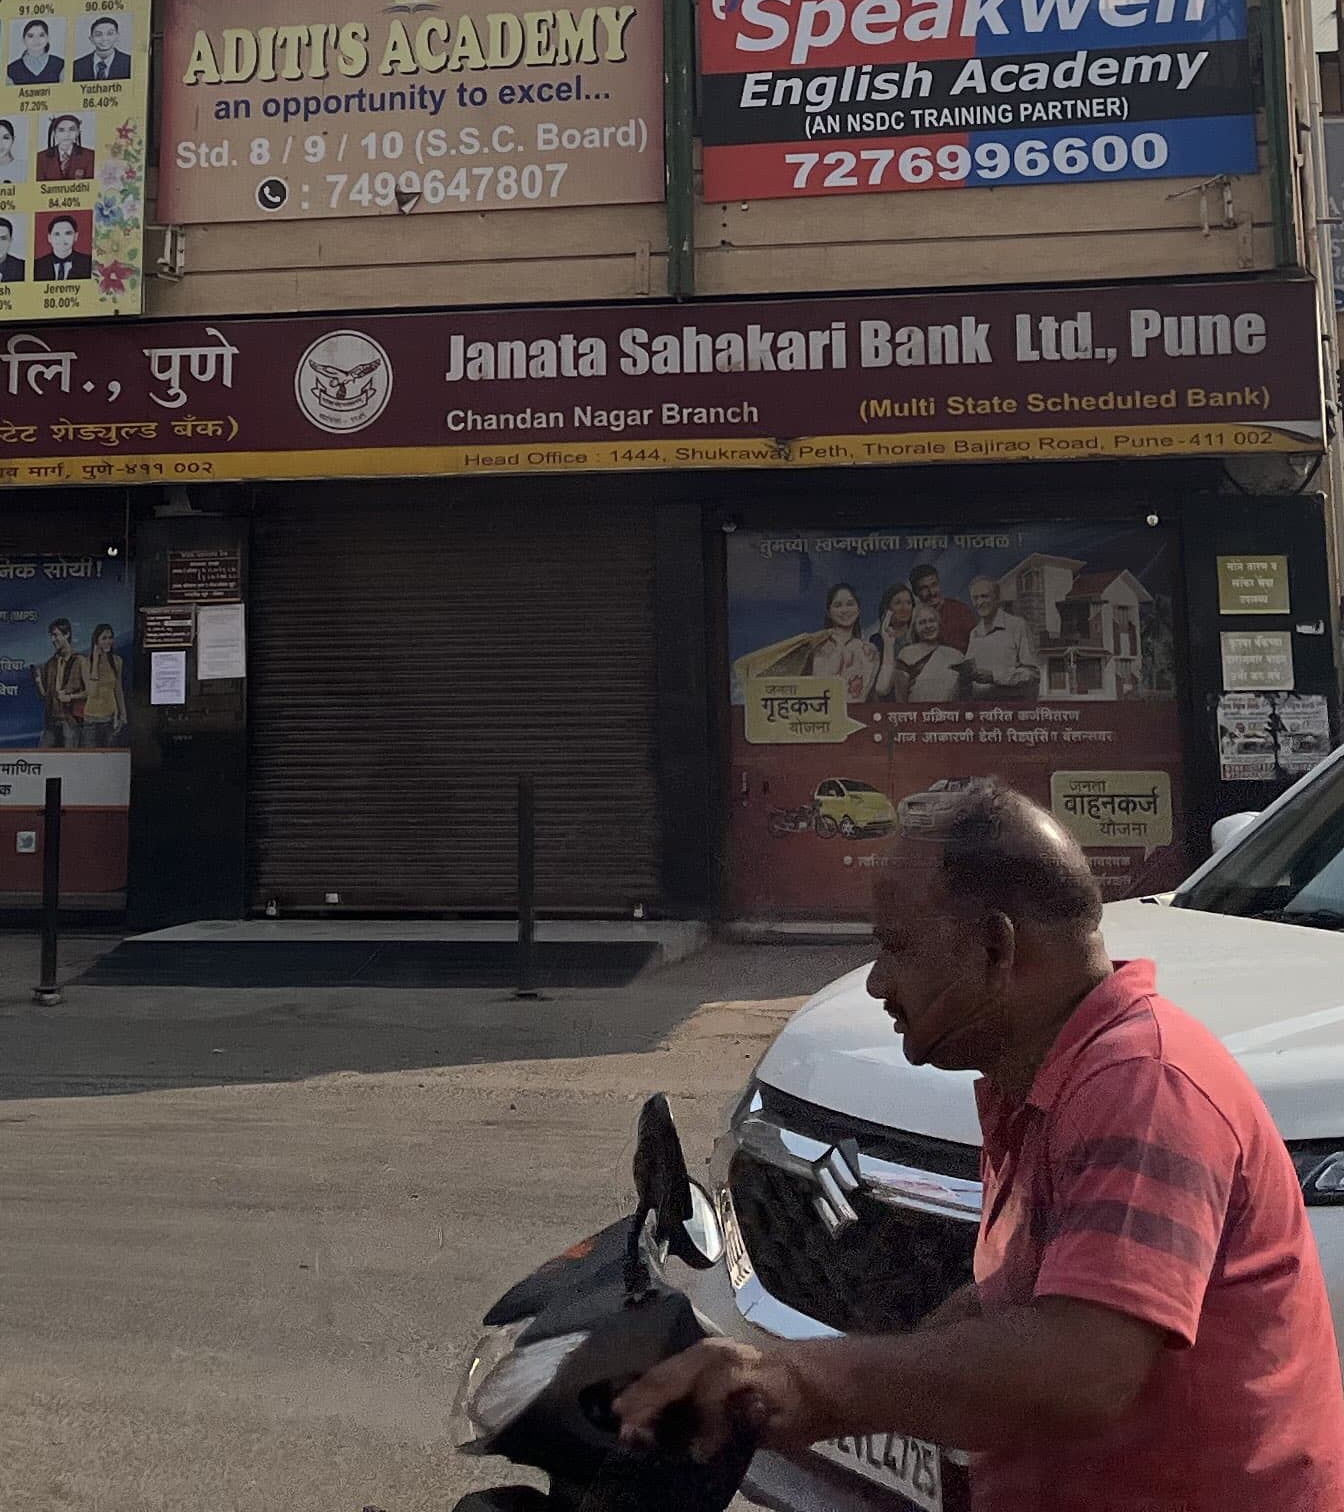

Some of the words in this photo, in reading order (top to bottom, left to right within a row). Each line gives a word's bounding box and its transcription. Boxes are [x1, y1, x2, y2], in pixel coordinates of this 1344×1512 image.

[18, 3, 55, 15] 91.00%
[183, 22, 369, 86] ADITI'S
[379, 5, 637, 76] ACADEMY
[214, 98, 251, 120] an
[261, 83, 447, 123] opportunity
[458, 81, 488, 107] to
[498, 75, 611, 105] excel...
[739, 65, 933, 113] English
[950, 50, 1209, 96] Academy
[804, 112, 843, 140] (AN
[847, 110, 906, 133] NSDC
[910, 104, 1014, 129] TRAINING
[1020, 96, 1130, 123] PARTNER)
[176, 139, 238, 169] Std.
[249, 137, 270, 166] 8
[303, 135, 326, 164] 9
[361, 130, 404, 160] 10
[415, 126, 524, 165] (S.S.C.
[536, 118, 649, 153] Board)
[784, 132, 1169, 188] 7276996600
[326, 163, 568, 209] 7499647807
[43, 283, 81, 296] Jeremy
[444, 331, 607, 382] Janata
[619, 321, 846, 377] Sahakari
[860, 315, 992, 369] Bank
[1015, 310, 1117, 364] Ltd.,
[1130, 308, 1267, 359] Pune
[143, 327, 240, 409] पुणे
[446, 408, 564, 432] Chandan
[574, 405, 653, 431] Nagar
[662, 402, 759, 426] Branch
[859, 395, 936, 424] (Multi
[947, 393, 1017, 416] State
[1027, 389, 1176, 414] Scheduled
[1187, 385, 1271, 411] Bank)
[171, 413, 240, 442] बँक)
[464, 452, 519, 467] Head
[527, 449, 588, 465] Office
[610, 448, 667, 465] 1444,
[799, 444, 854, 460] Peth,
[862, 440, 946, 457] Thorale
[954, 437, 1031, 455] Bajirao
[1039, 434, 1104, 453] Road,
[1234, 429, 1274, 446] 002
[761, 690, 832, 720] गृहकर्ज
[1062, 786, 1159, 820] वाहनकर्ज
